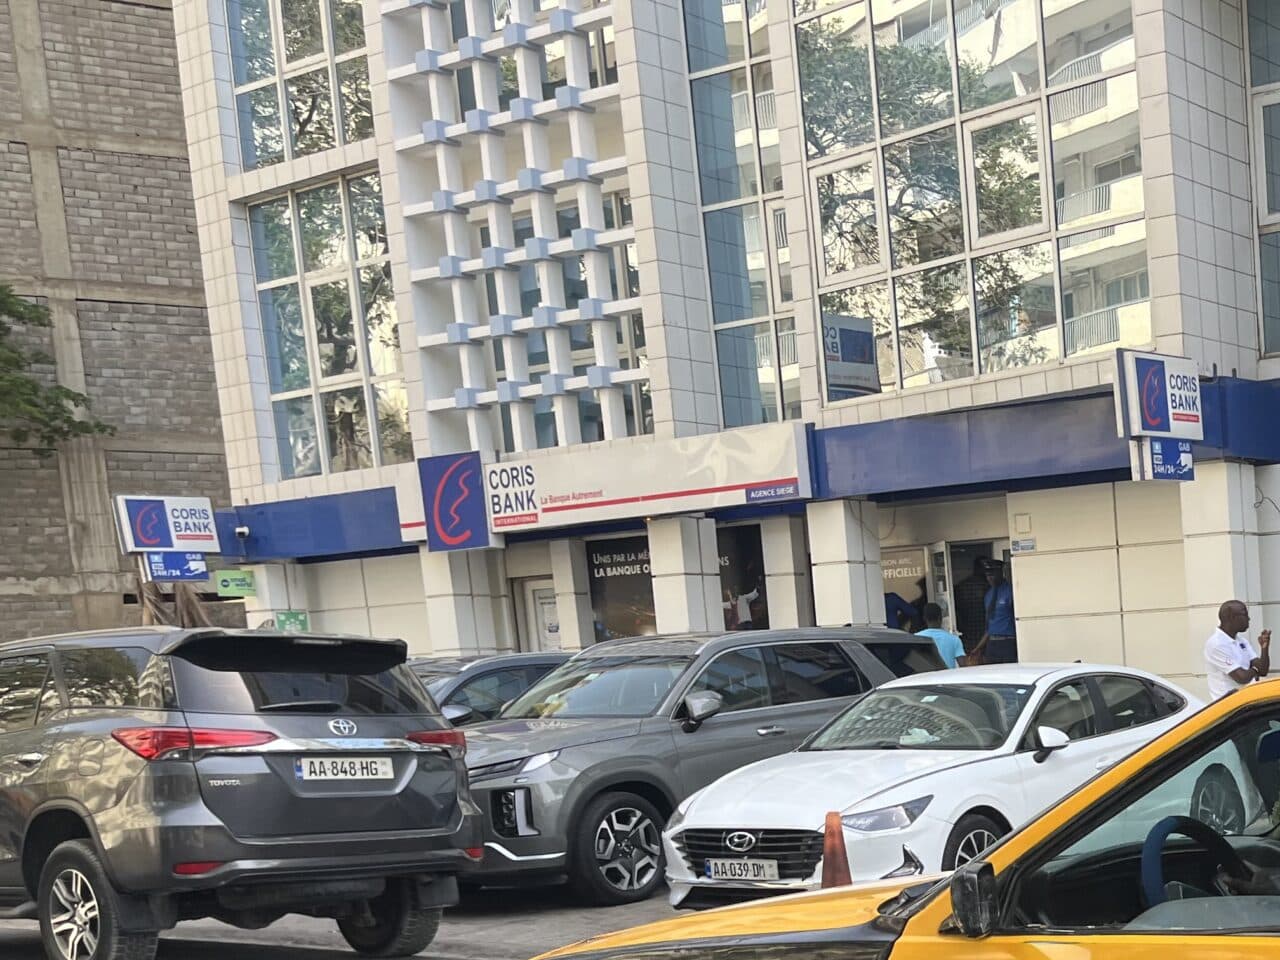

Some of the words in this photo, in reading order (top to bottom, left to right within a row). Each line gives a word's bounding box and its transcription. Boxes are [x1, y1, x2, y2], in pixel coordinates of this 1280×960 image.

[1169, 373, 1198, 393] CORIS
[1171, 393, 1199, 412] BANK
[489, 464, 535, 490] CORIS
[491, 489, 537, 515] BANK
[171, 508, 210, 520] CORIS
[173, 521, 213, 533] BANK
[627, 552, 636, 562] LA
[594, 567, 605, 578] LA
[606, 564, 641, 577] BANQUE
[881, 567, 921, 579] FFICIELLE
[308, 760, 378, 777] AA-848-HG
